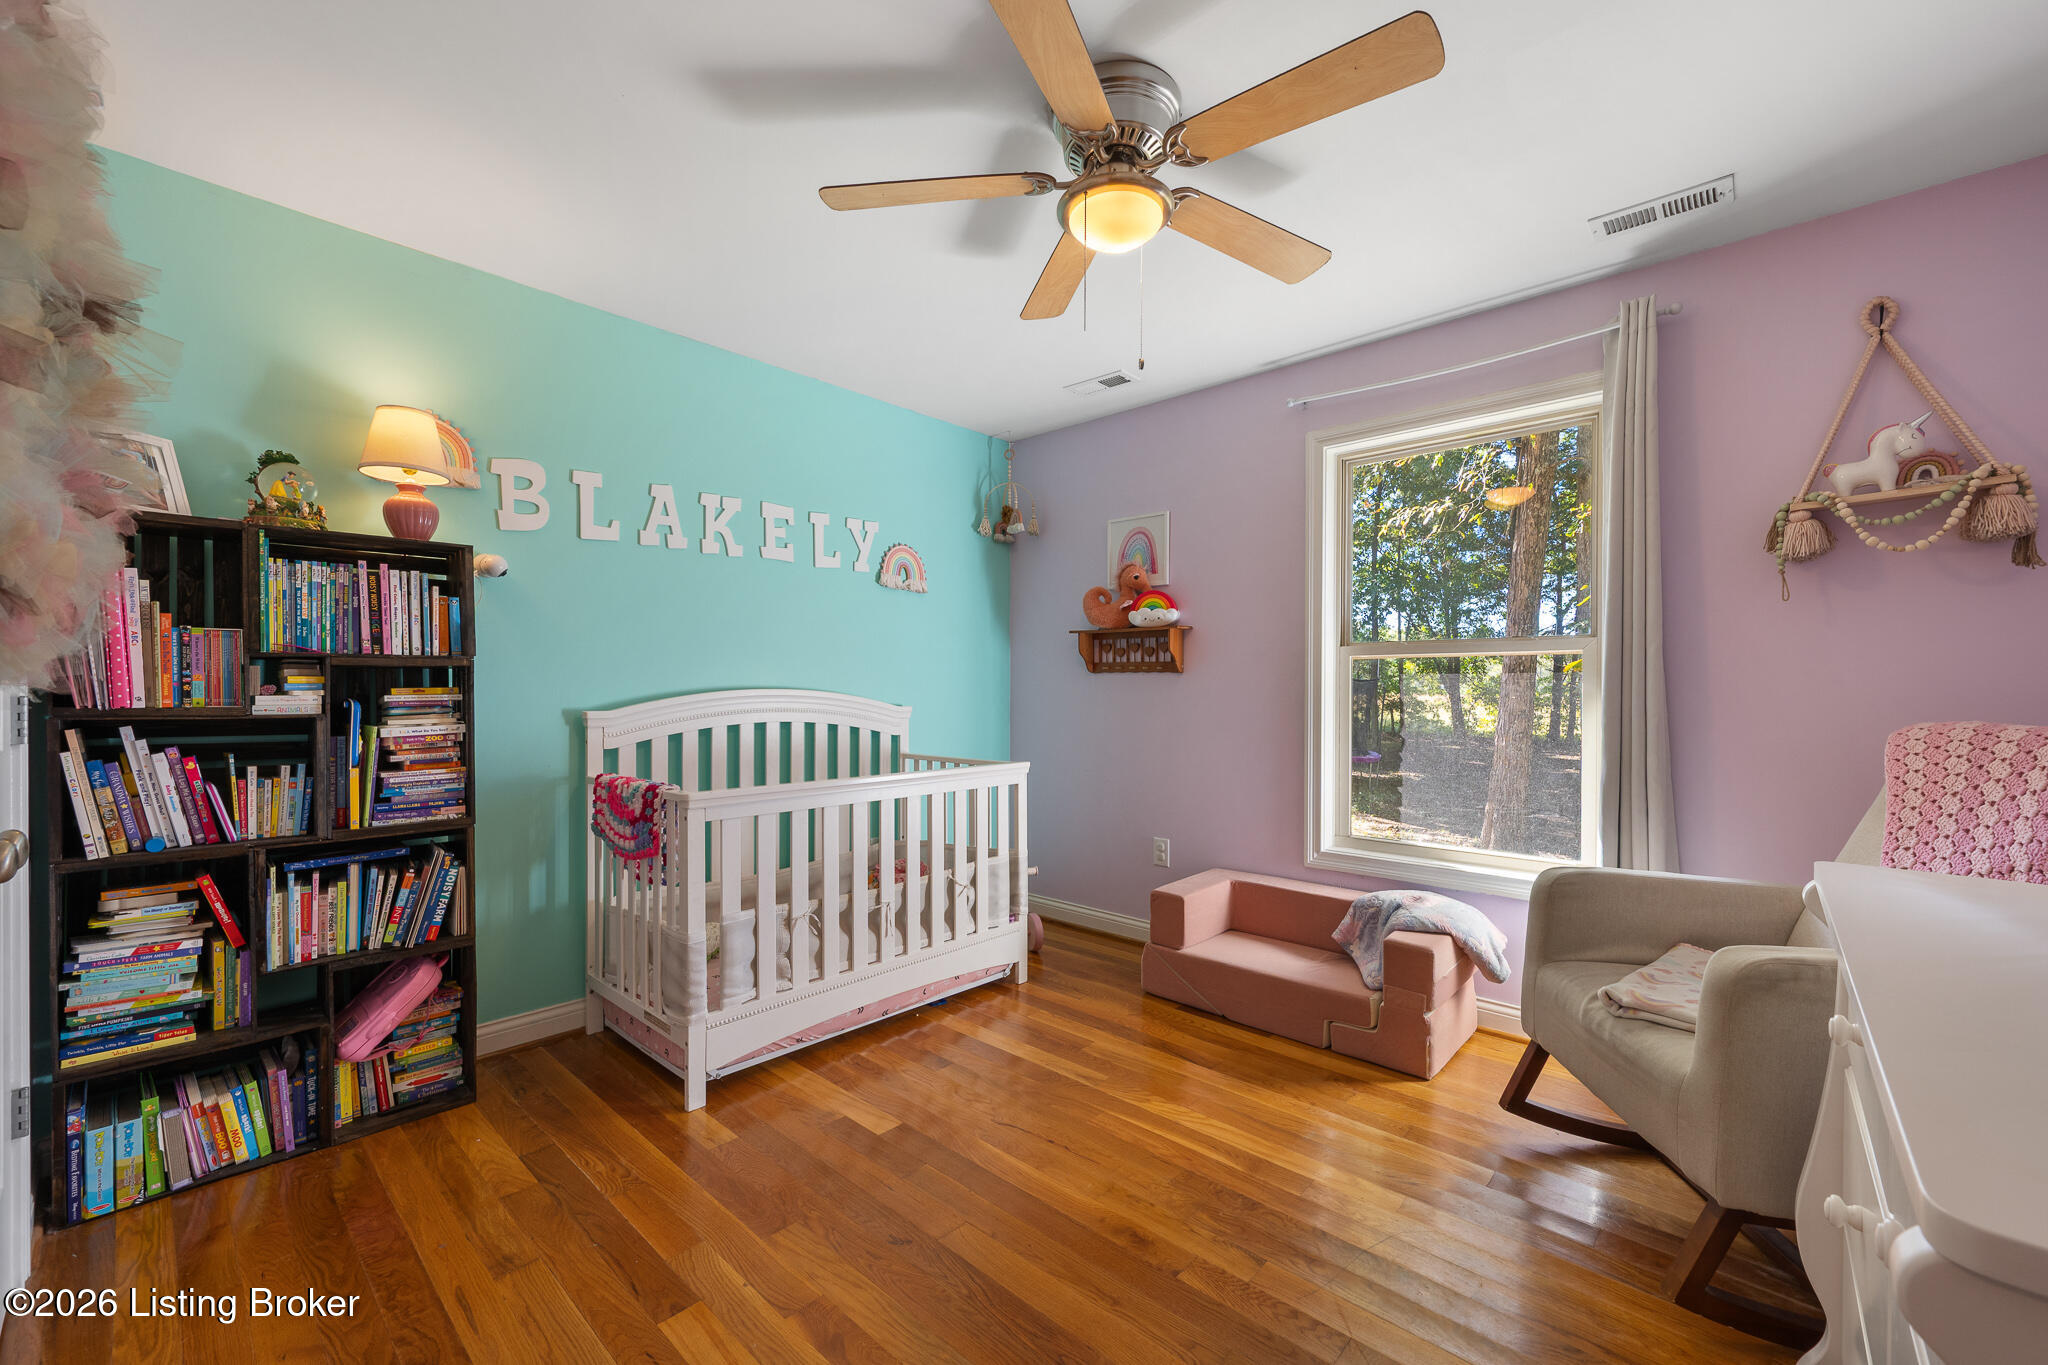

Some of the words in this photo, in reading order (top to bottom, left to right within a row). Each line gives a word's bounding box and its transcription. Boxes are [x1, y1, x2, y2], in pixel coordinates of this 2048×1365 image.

[488, 456, 879, 573] BLAKELY
[368, 575, 376, 592] NOISY
[369, 593, 377, 610] NOISY
[130, 630, 138, 646] ABCs
[134, 768, 144, 782] Peek
[68, 777, 79, 797] Colors
[139, 782, 147, 792] and
[108, 769, 128, 805] GRANDMA
[120, 808, 137, 835] WISHES
[141, 792, 151, 807] Play!
[164, 783, 172, 796] Baby
[168, 794, 178, 812] Animals
[189, 814, 199, 828] Sleep
[440, 867, 459, 897] NOISY
[431, 896, 449, 923] FARM
[106, 1015, 134, 1025] PUMPKINS
[307, 1076, 316, 1100] TUCK-IN
[307, 1101, 316, 1117] TIME
[215, 1131, 228, 1150] BOO
[229, 1127, 242, 1148] MOO
[71, 1149, 79, 1170] BEDTIME
[70, 1171, 79, 1197] FAVORITES
